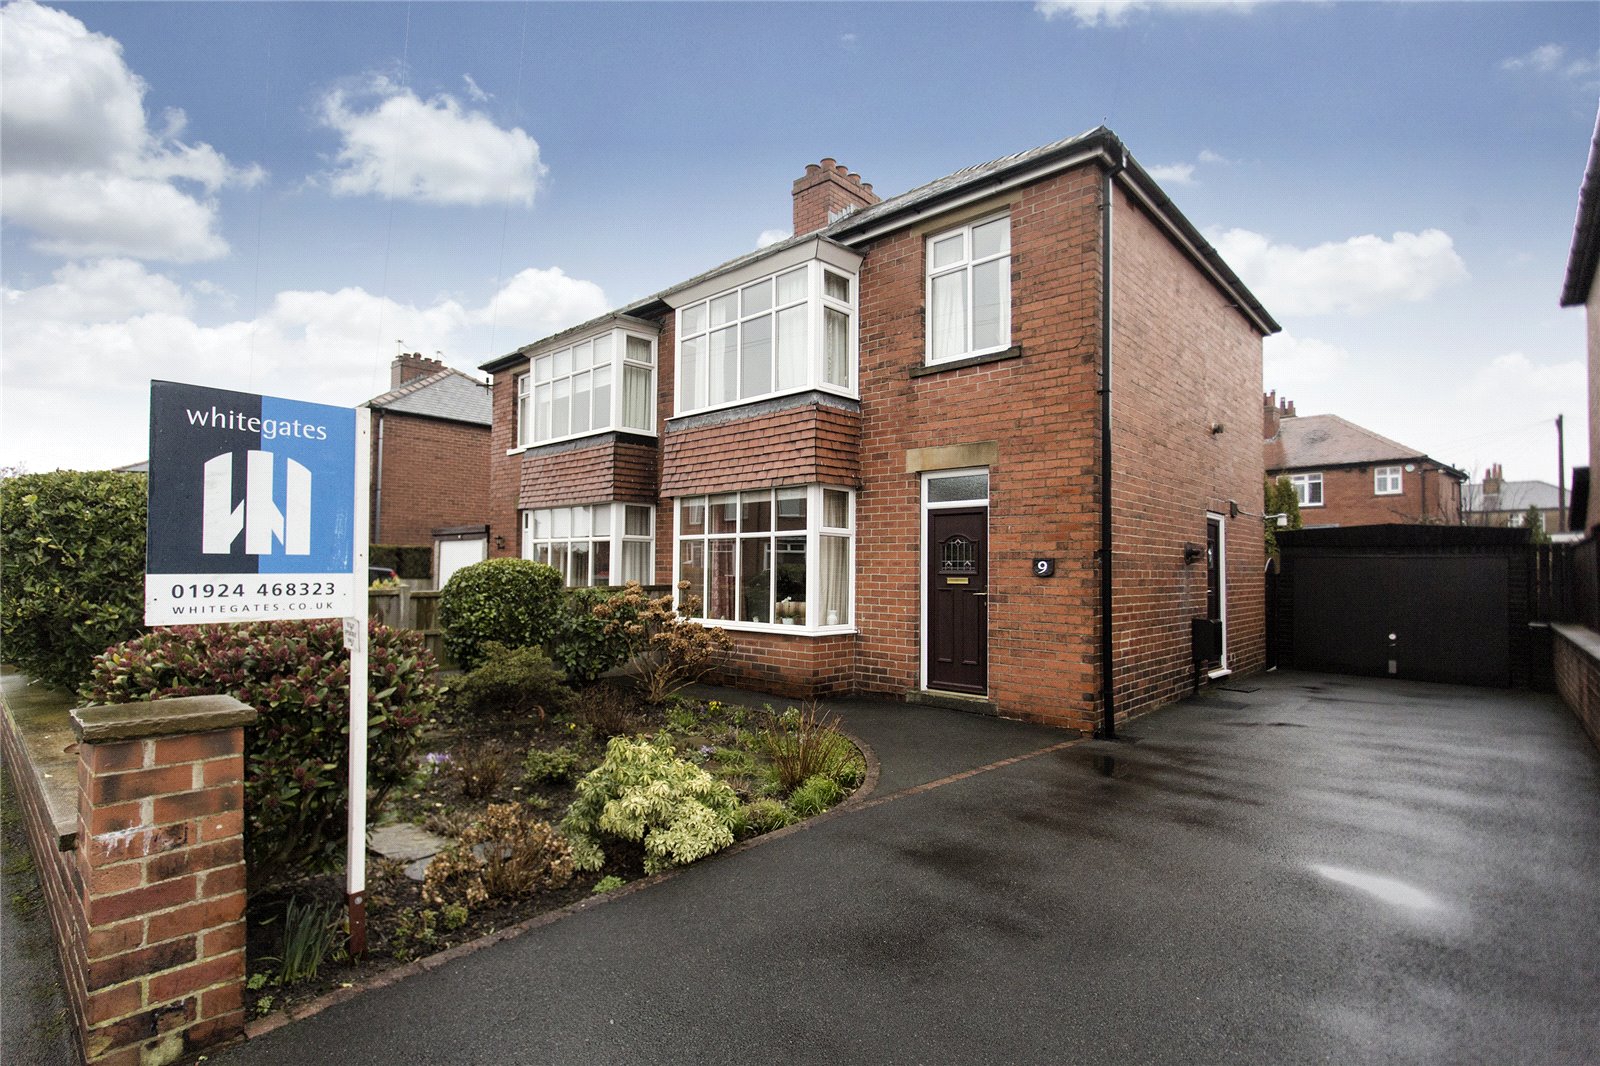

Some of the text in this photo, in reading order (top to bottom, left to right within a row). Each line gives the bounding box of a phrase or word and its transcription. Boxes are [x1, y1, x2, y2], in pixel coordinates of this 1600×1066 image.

[186, 406, 327, 440] whitegates
[1037, 560, 1048, 574] 9
[171, 582, 336, 599] 01924 468323
[172, 602, 333, 615] WHITEGATES.CO.UK
